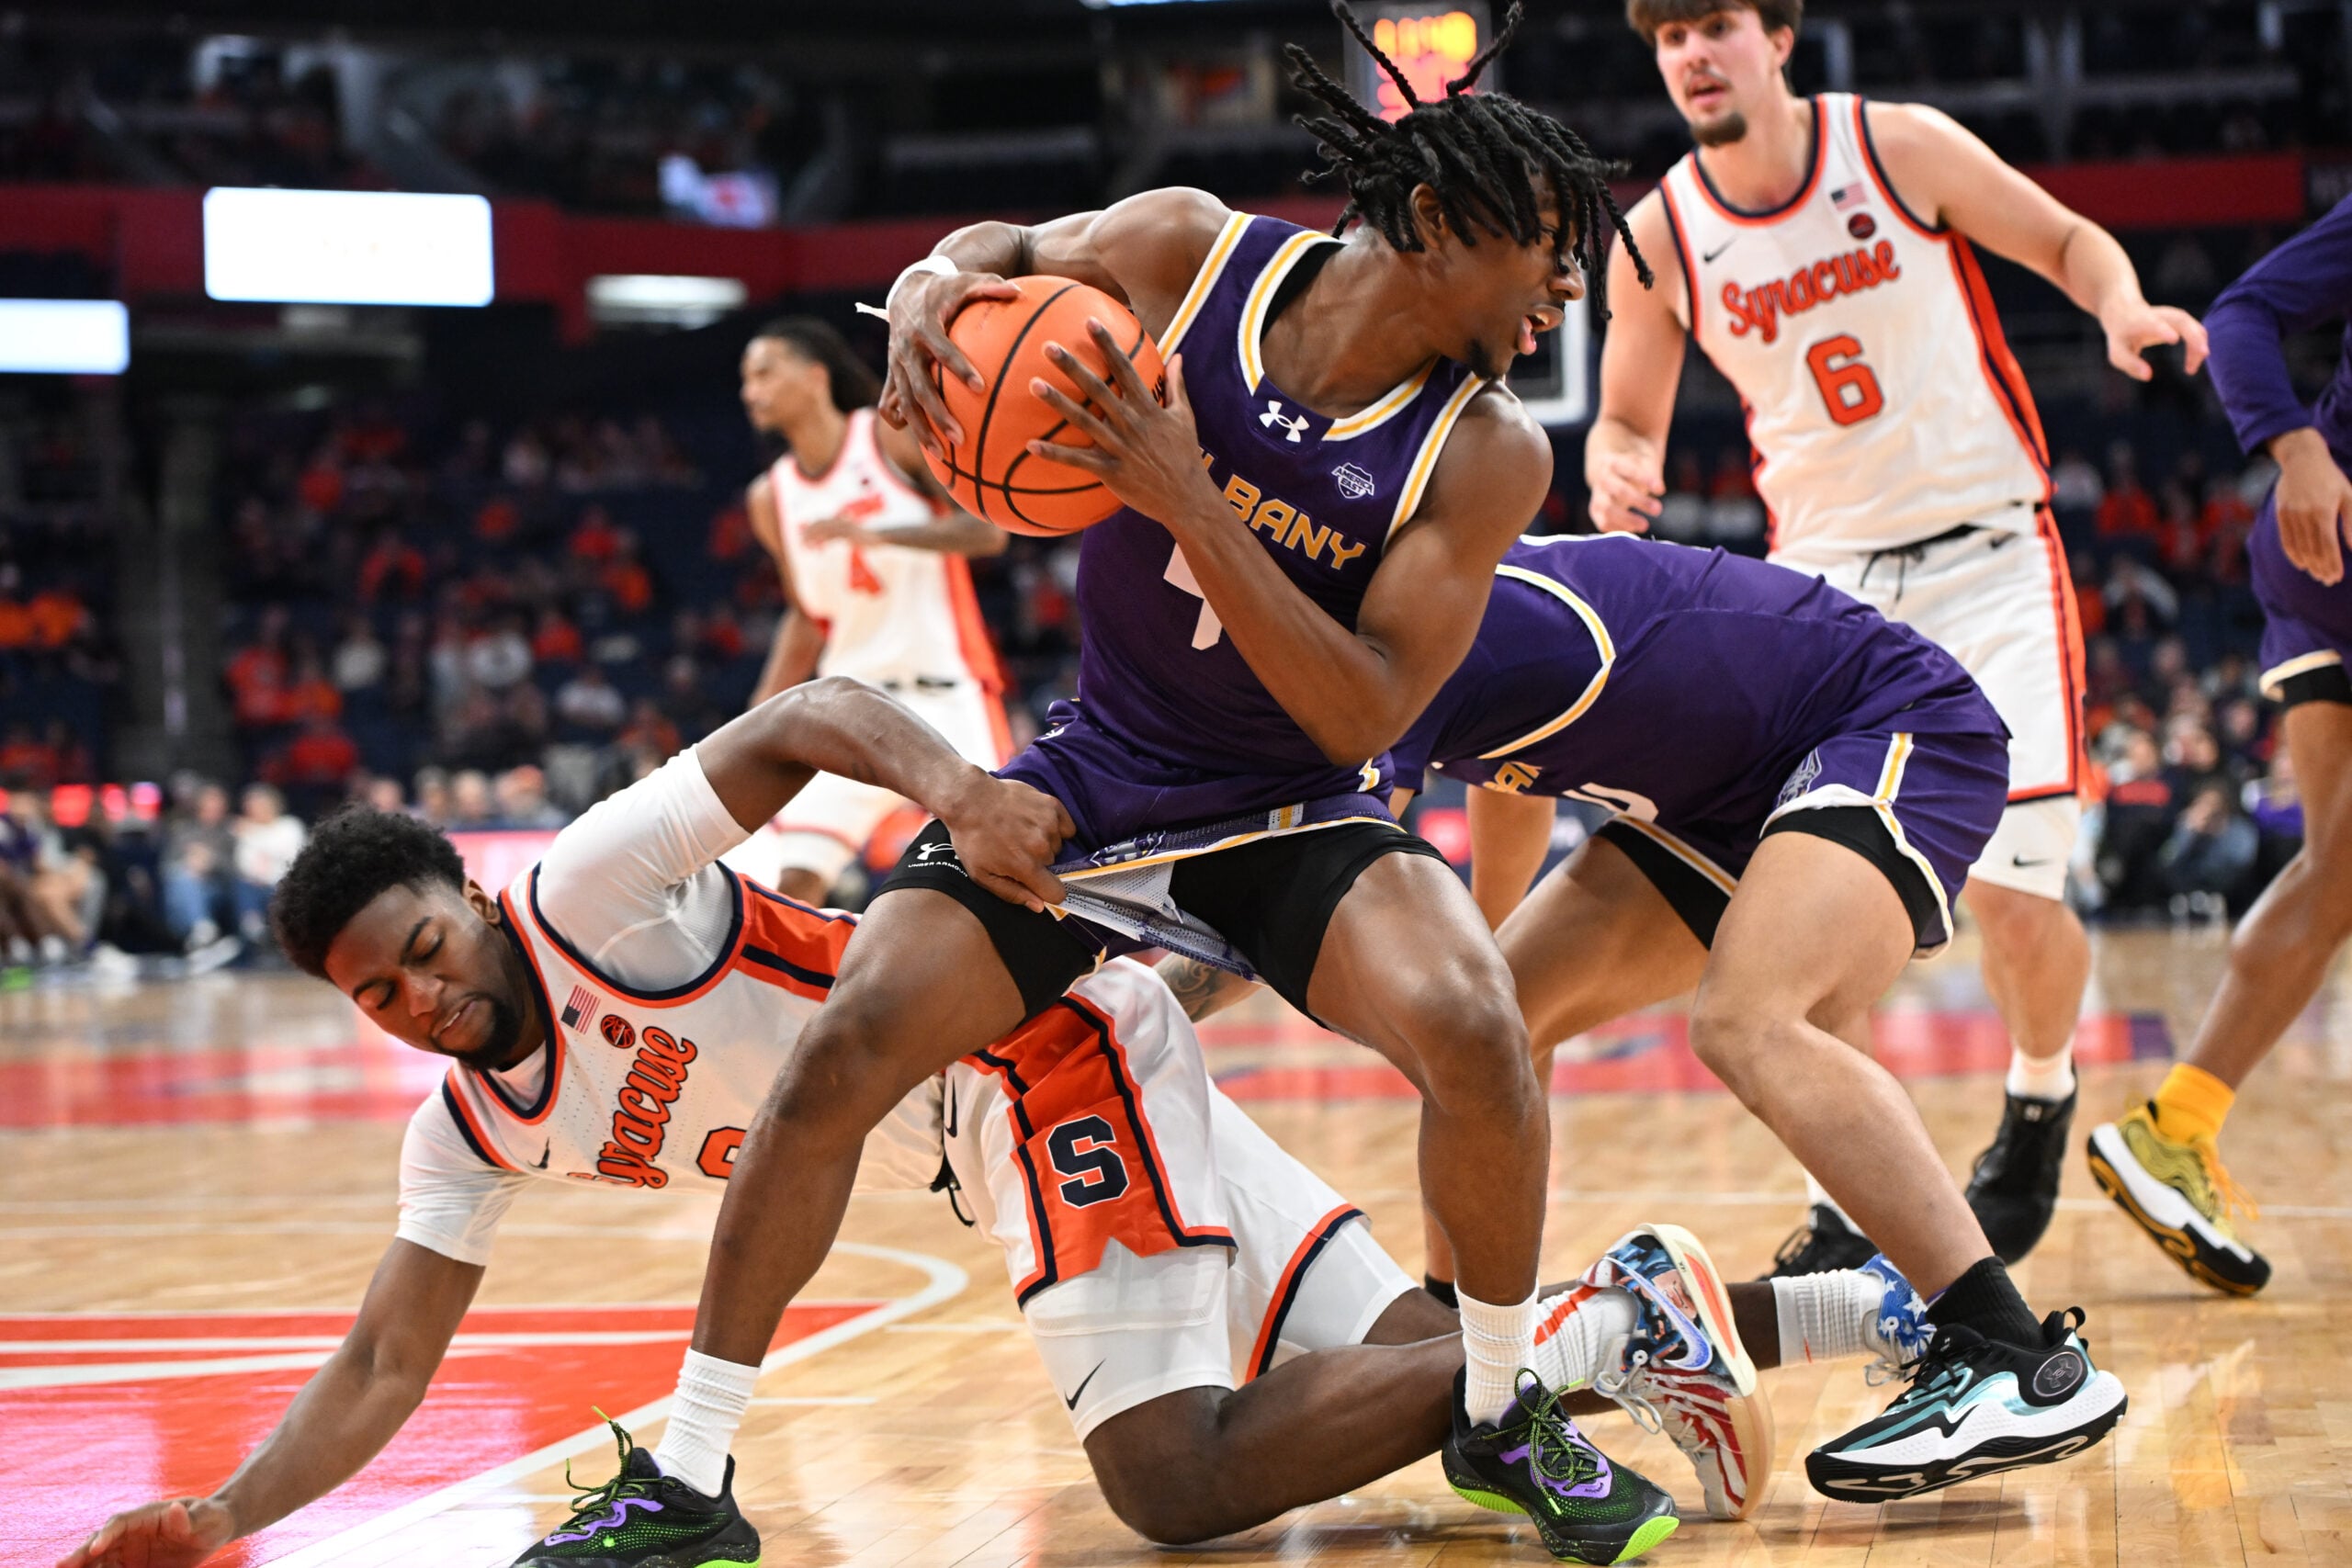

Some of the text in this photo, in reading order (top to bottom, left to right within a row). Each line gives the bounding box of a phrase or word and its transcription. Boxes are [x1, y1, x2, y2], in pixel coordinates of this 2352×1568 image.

[1721, 240, 1902, 344] Syracuse
[1805, 333, 1885, 427] 6
[1335, 467, 1374, 494] AMERICA
[1340, 477, 1365, 494] EAST
[936, 861, 968, 877] ARMOUR
[566, 1026, 698, 1189] yracuse
[1046, 1113, 1130, 1210] S
